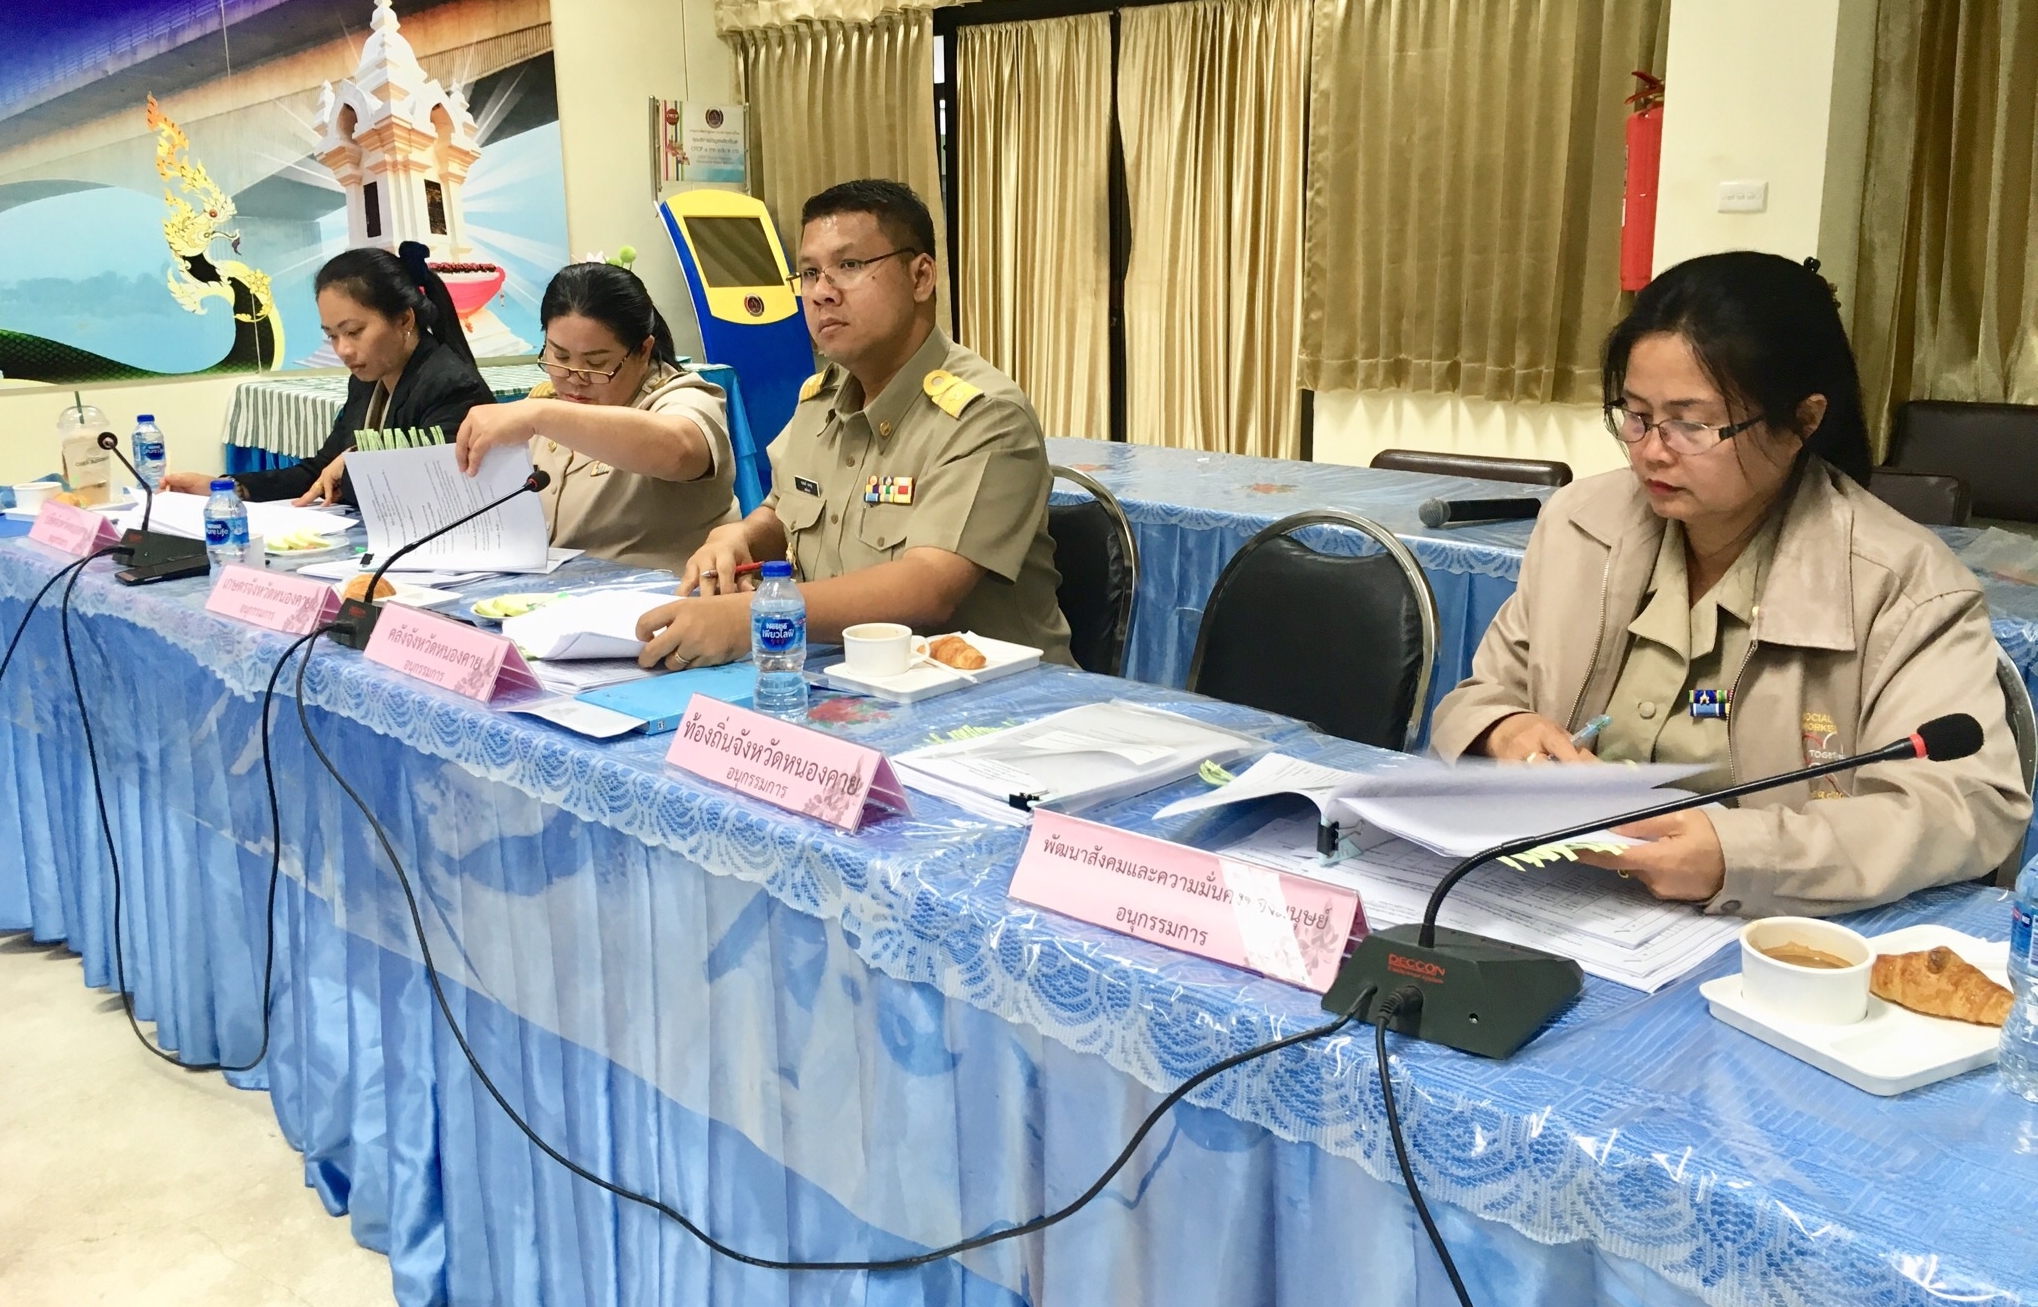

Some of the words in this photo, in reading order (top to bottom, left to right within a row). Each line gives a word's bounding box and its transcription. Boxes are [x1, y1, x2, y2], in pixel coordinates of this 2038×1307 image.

[388, 623, 484, 671] คลังจังหวัดหนองคาย
[403, 659, 446, 682] อนุกรรมการ
[683, 712, 862, 796] ท้องถิ่นจังหวัดหนองคาย
[726, 765, 789, 799] อนุกรรมการ
[1115, 904, 1209, 947] อนุกรรมการ
[1388, 953, 1446, 976] DECCON
